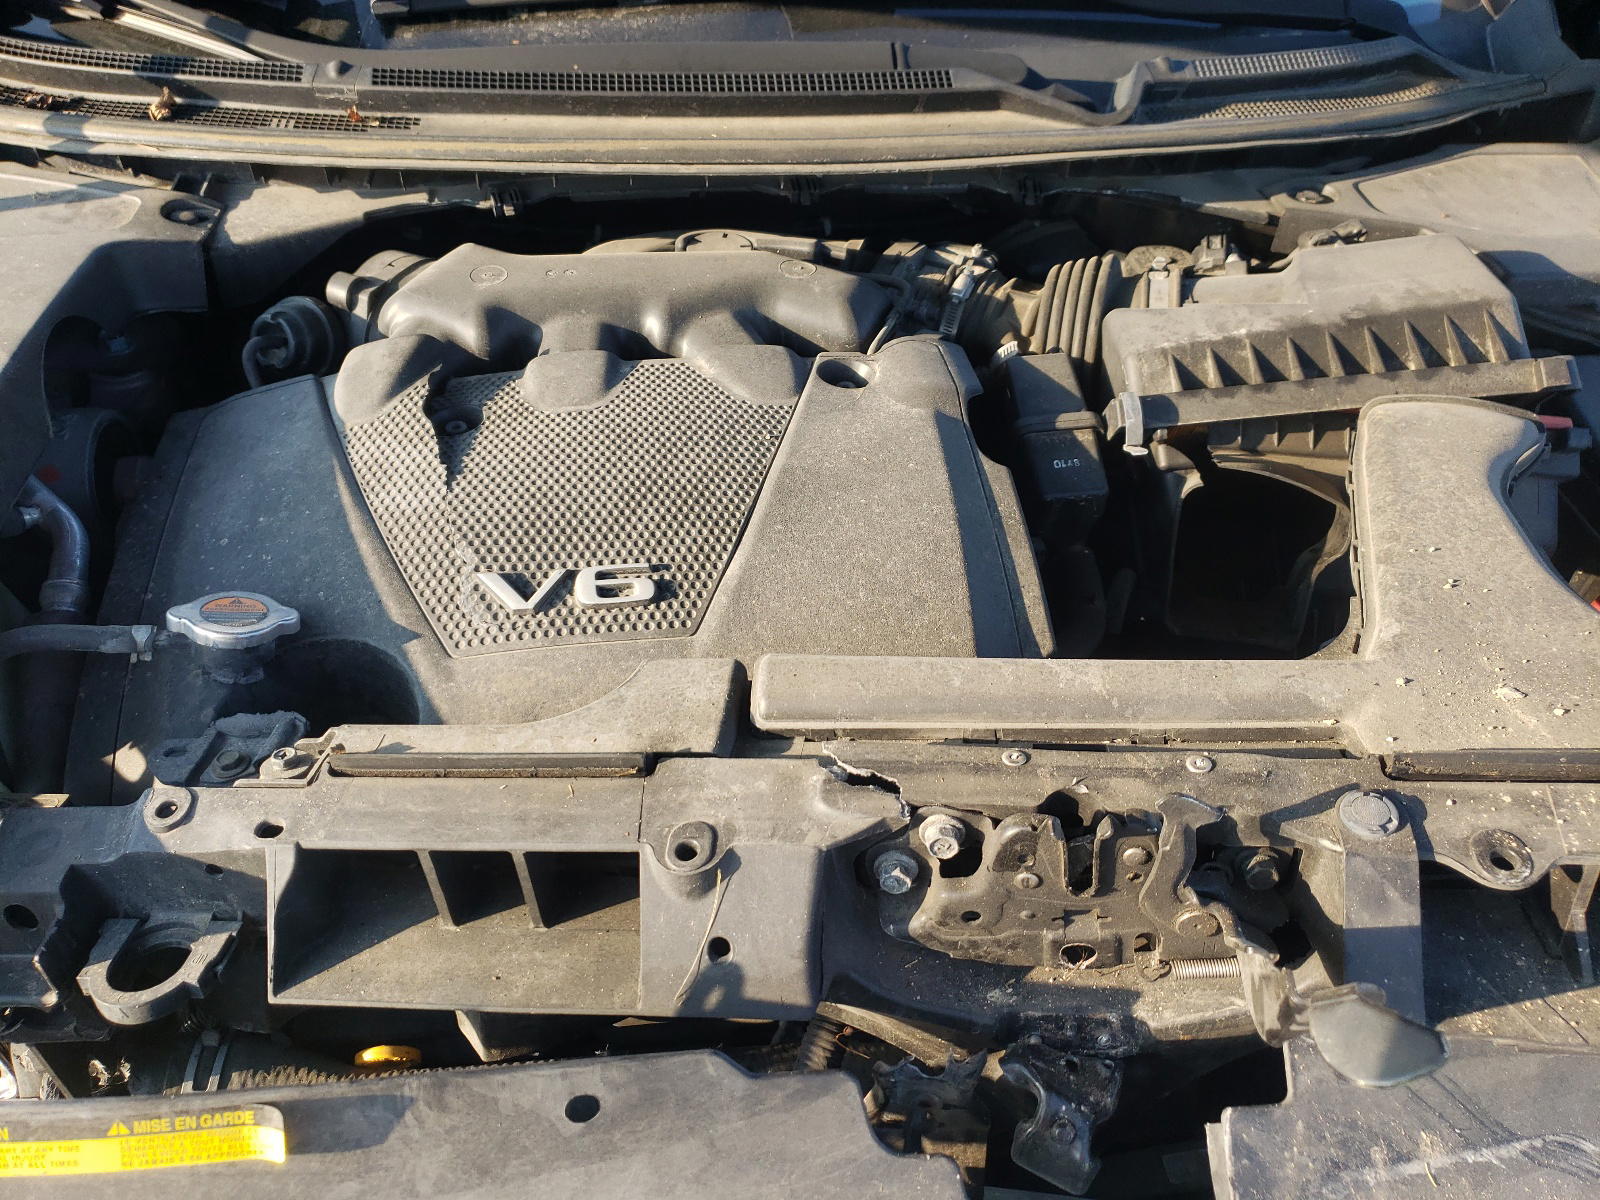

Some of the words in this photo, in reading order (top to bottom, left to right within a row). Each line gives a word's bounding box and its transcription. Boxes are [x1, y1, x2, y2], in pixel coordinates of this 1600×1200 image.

[476, 562, 656, 615] V6
[133, 1118, 171, 1134] MISE
[175, 1116, 197, 1131] EN
[200, 1111, 256, 1128] GARDE
